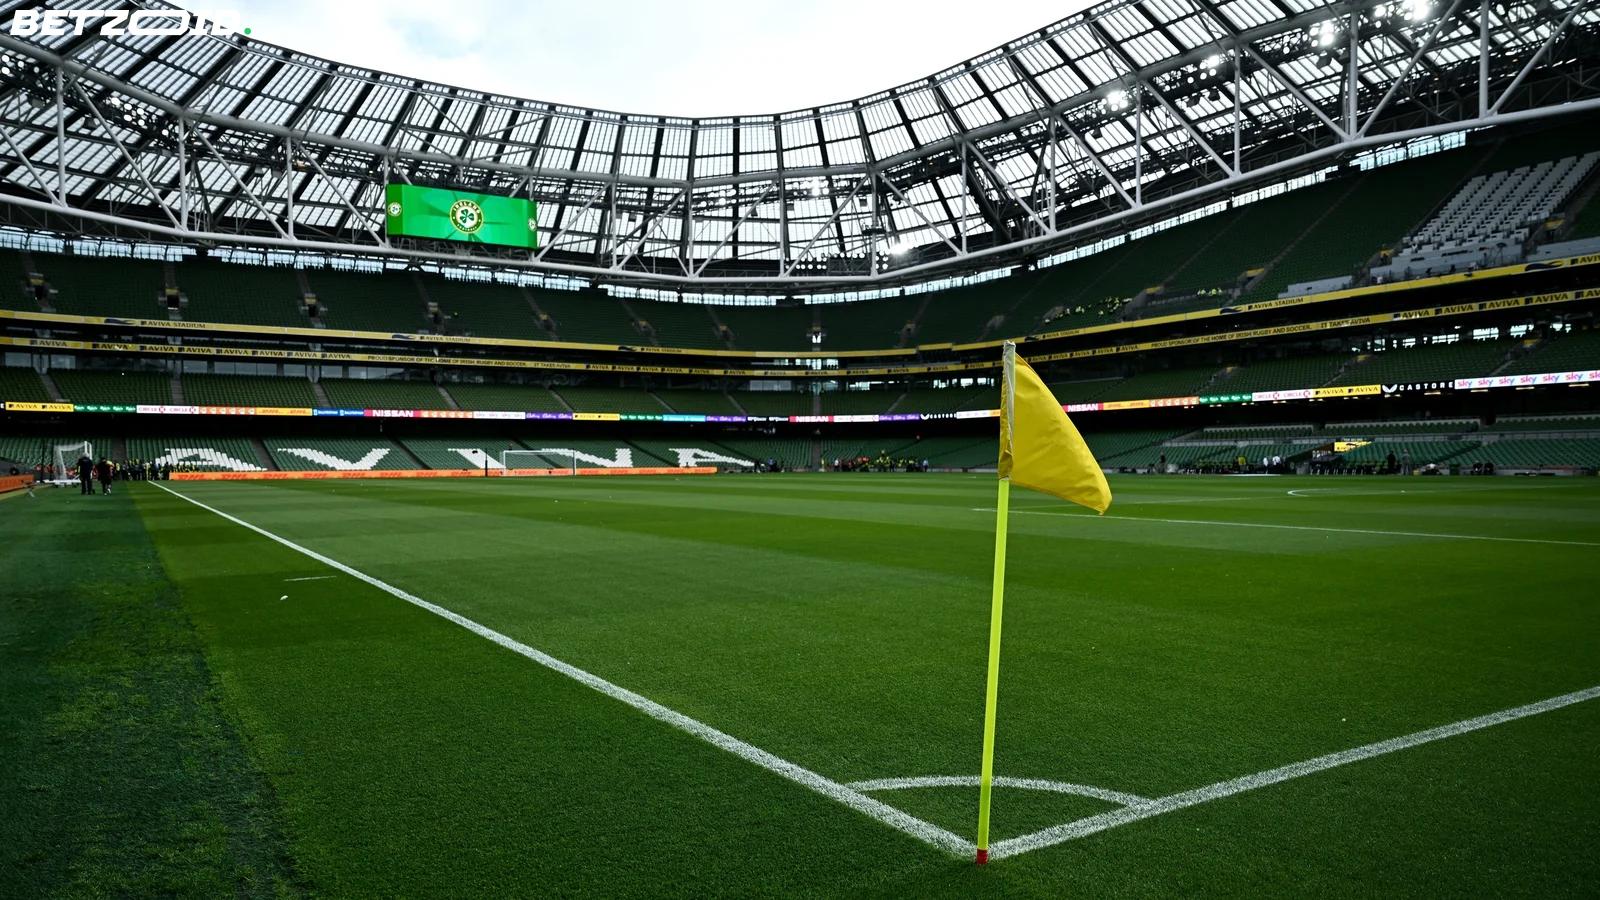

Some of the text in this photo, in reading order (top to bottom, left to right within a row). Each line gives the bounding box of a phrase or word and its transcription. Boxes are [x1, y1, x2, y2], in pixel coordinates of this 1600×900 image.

[1275, 298, 1304, 306] STADIUM
[1444, 304, 1474, 314] AVIVA
[1488, 300, 1520, 309] AVIVA
[1534, 293, 1569, 303] AVIVA
[1402, 310, 1430, 318] AVIVA
[1499, 377, 1515, 385] sky
[1520, 375, 1537, 384] sky
[1542, 373, 1560, 382] sky
[1566, 371, 1583, 380] sky
[1400, 382, 1453, 390] CASTORE
[1068, 403, 1098, 412] NISSAN
